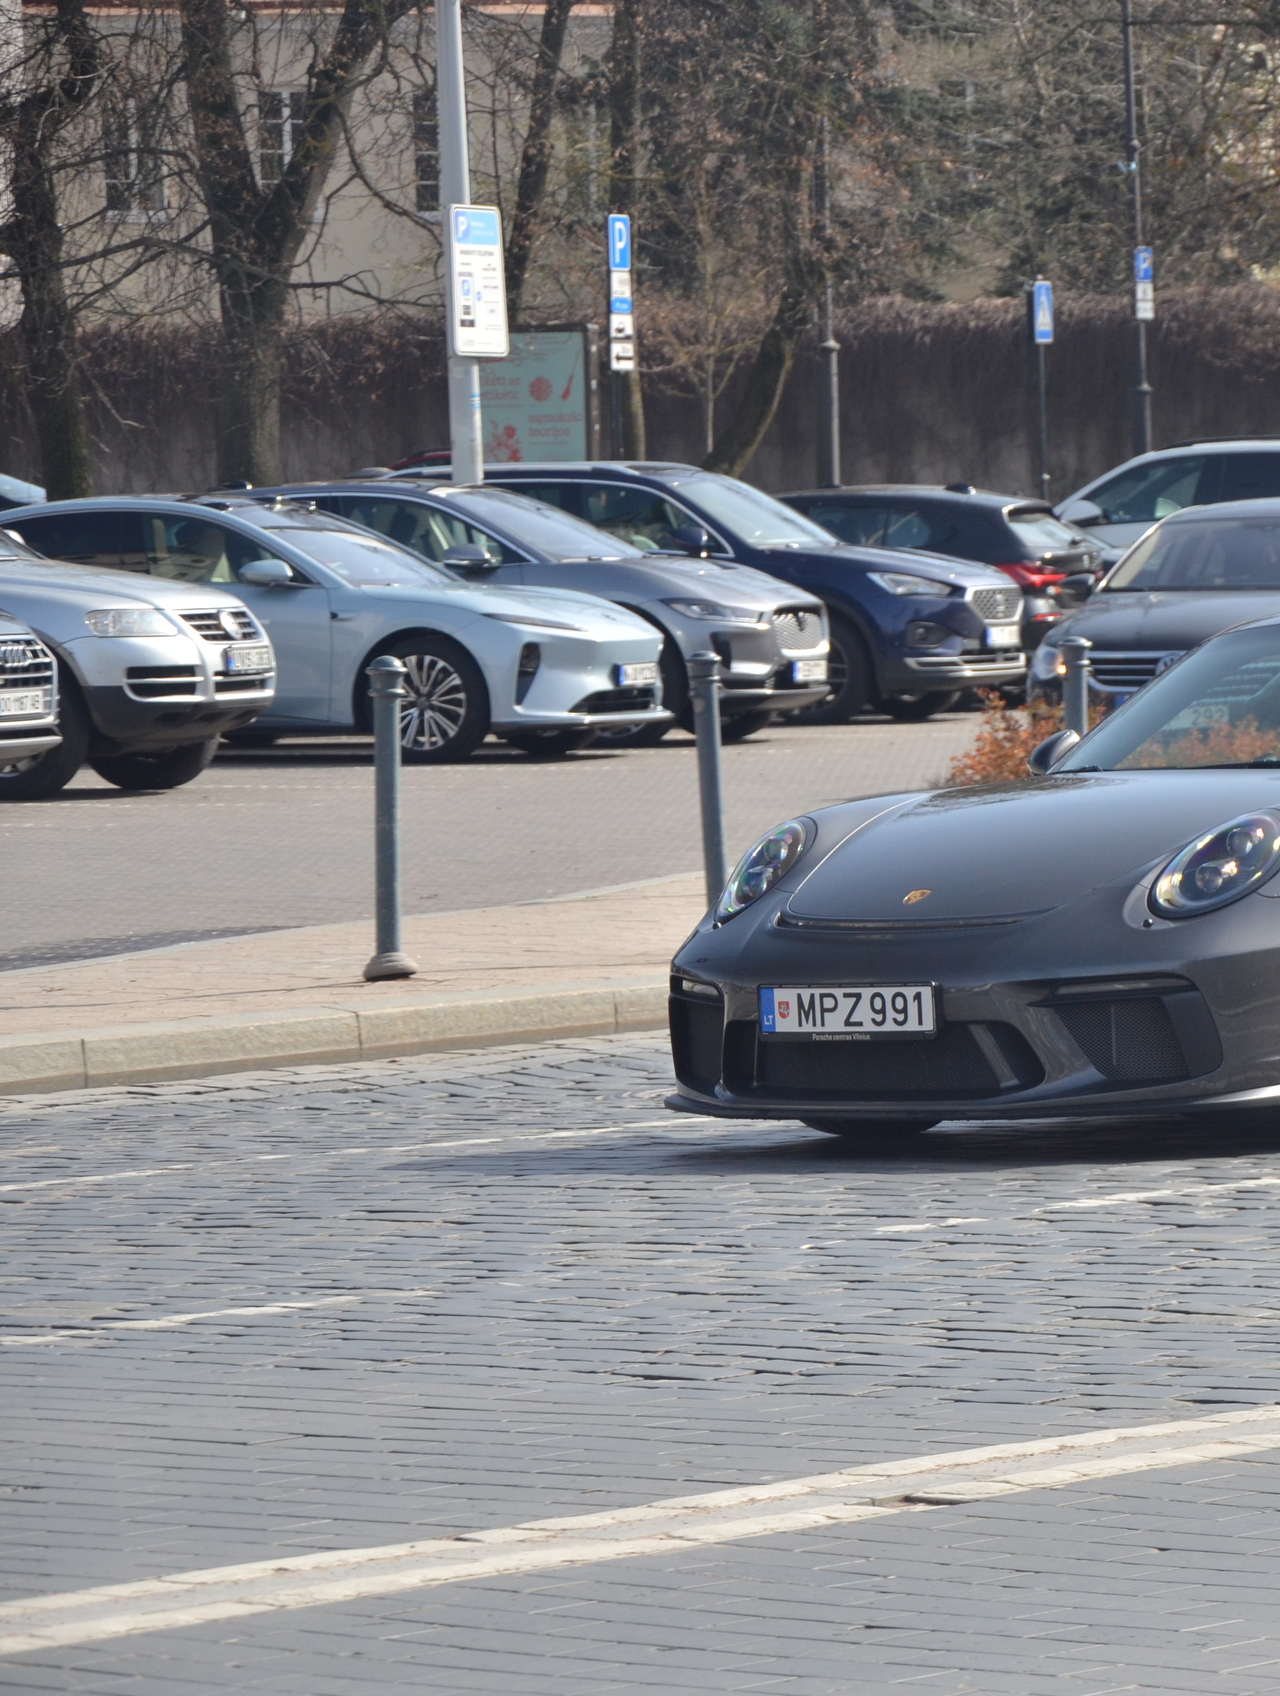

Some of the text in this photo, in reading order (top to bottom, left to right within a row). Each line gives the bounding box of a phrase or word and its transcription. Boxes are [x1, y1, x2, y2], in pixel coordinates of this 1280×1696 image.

[457, 216, 468, 238] P
[614, 221, 627, 264] P
[763, 1015, 773, 1026] LT
[812, 1033, 832, 1041] Porsche
[852, 1032, 871, 1041] Vilnius
